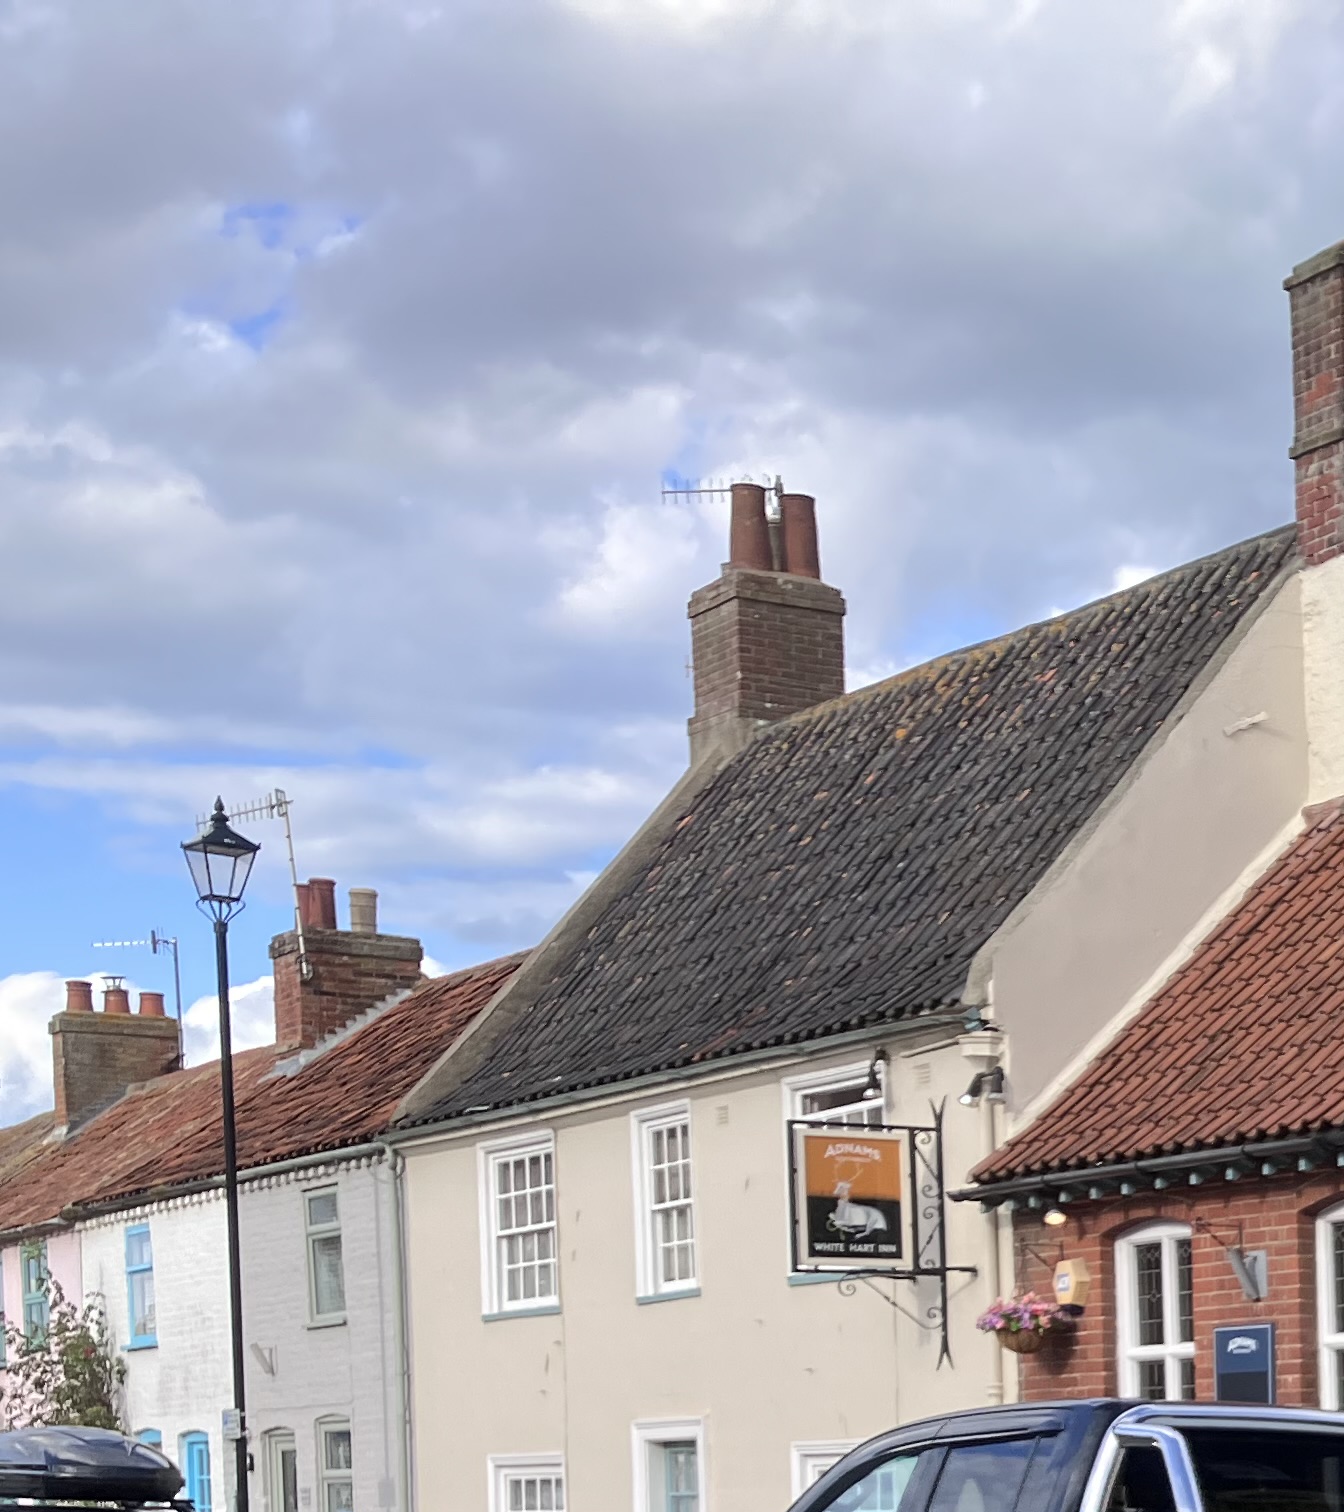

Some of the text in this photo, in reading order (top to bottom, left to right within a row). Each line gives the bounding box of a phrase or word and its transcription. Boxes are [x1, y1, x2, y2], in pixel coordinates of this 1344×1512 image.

[813, 1242, 896, 1252] WHITE HART INN
